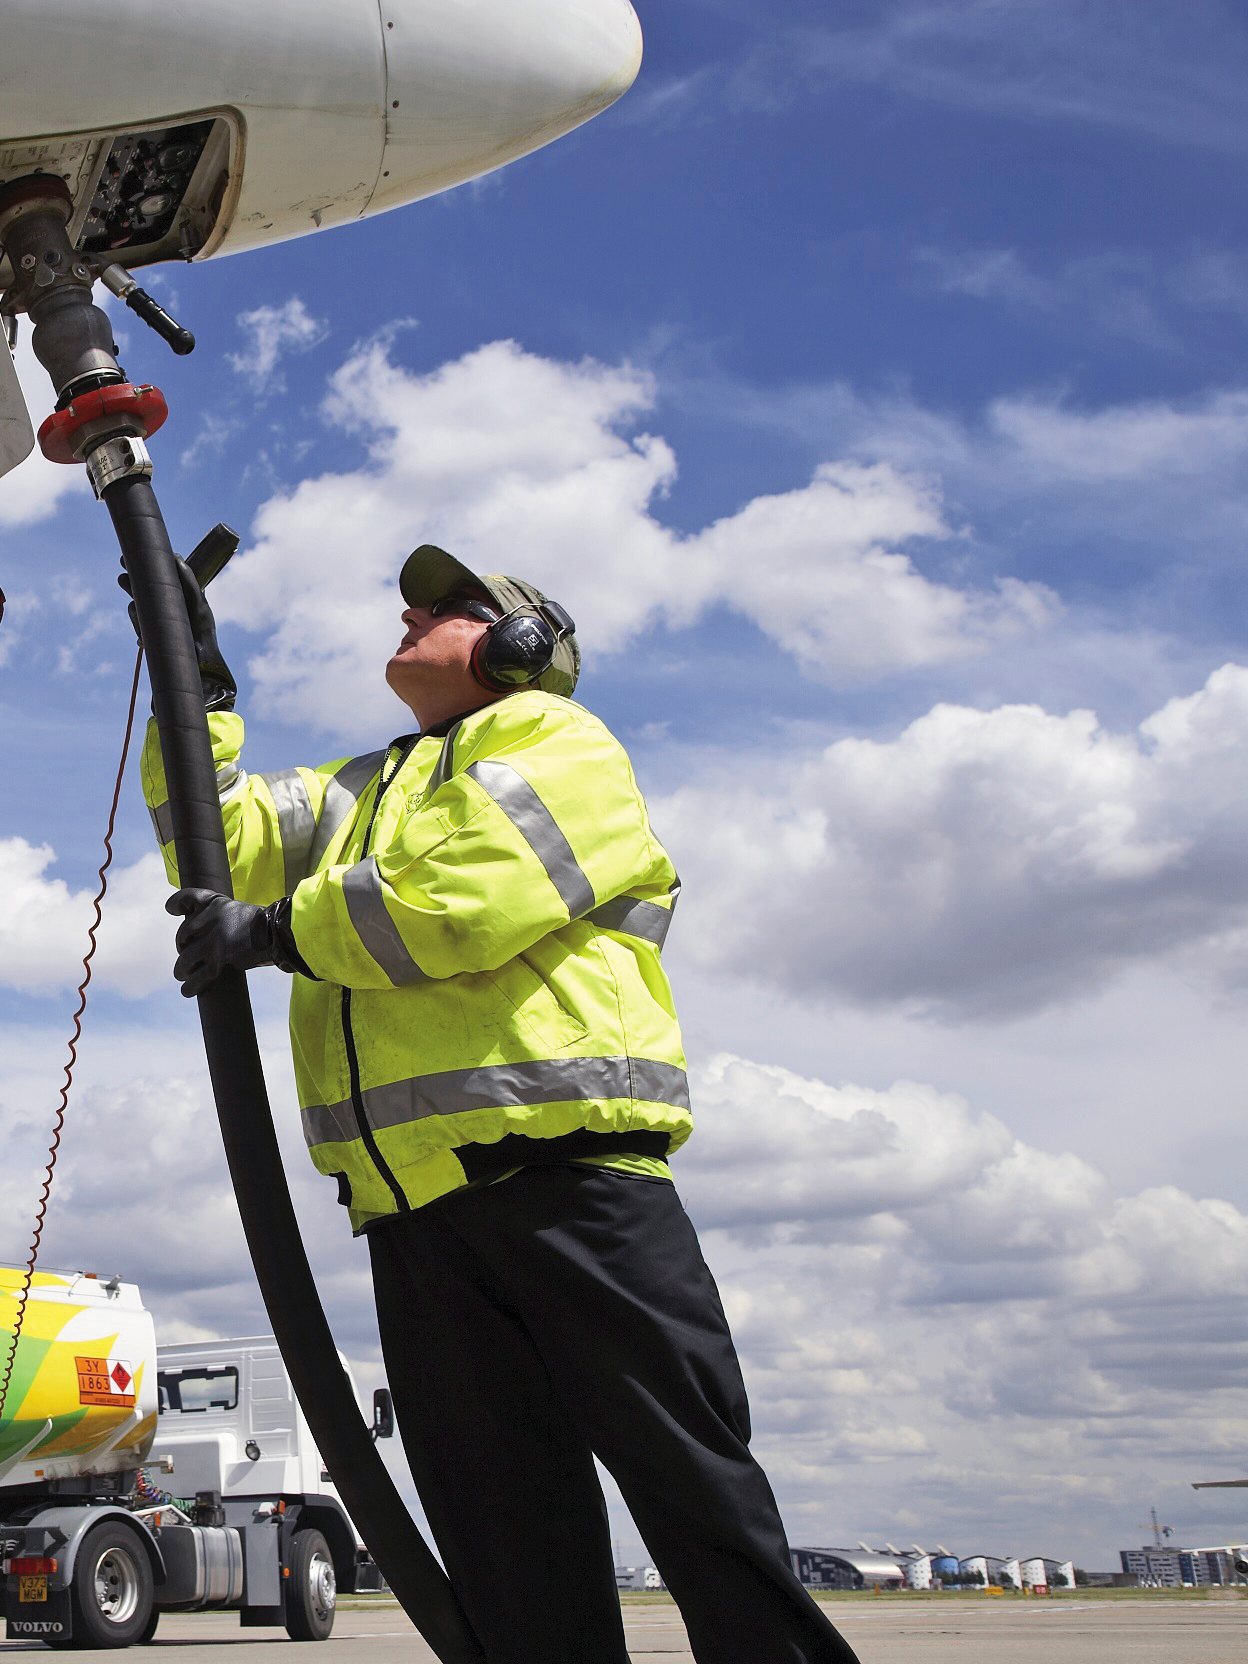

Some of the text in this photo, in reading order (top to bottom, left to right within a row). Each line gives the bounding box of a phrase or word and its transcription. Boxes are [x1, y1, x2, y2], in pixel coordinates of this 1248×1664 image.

[85, 1360, 99, 1373] 3Y
[81, 1376, 111, 1390] 1863
[20, 1577, 47, 1589] V373
[11, 1621, 64, 1633] VOLVO
